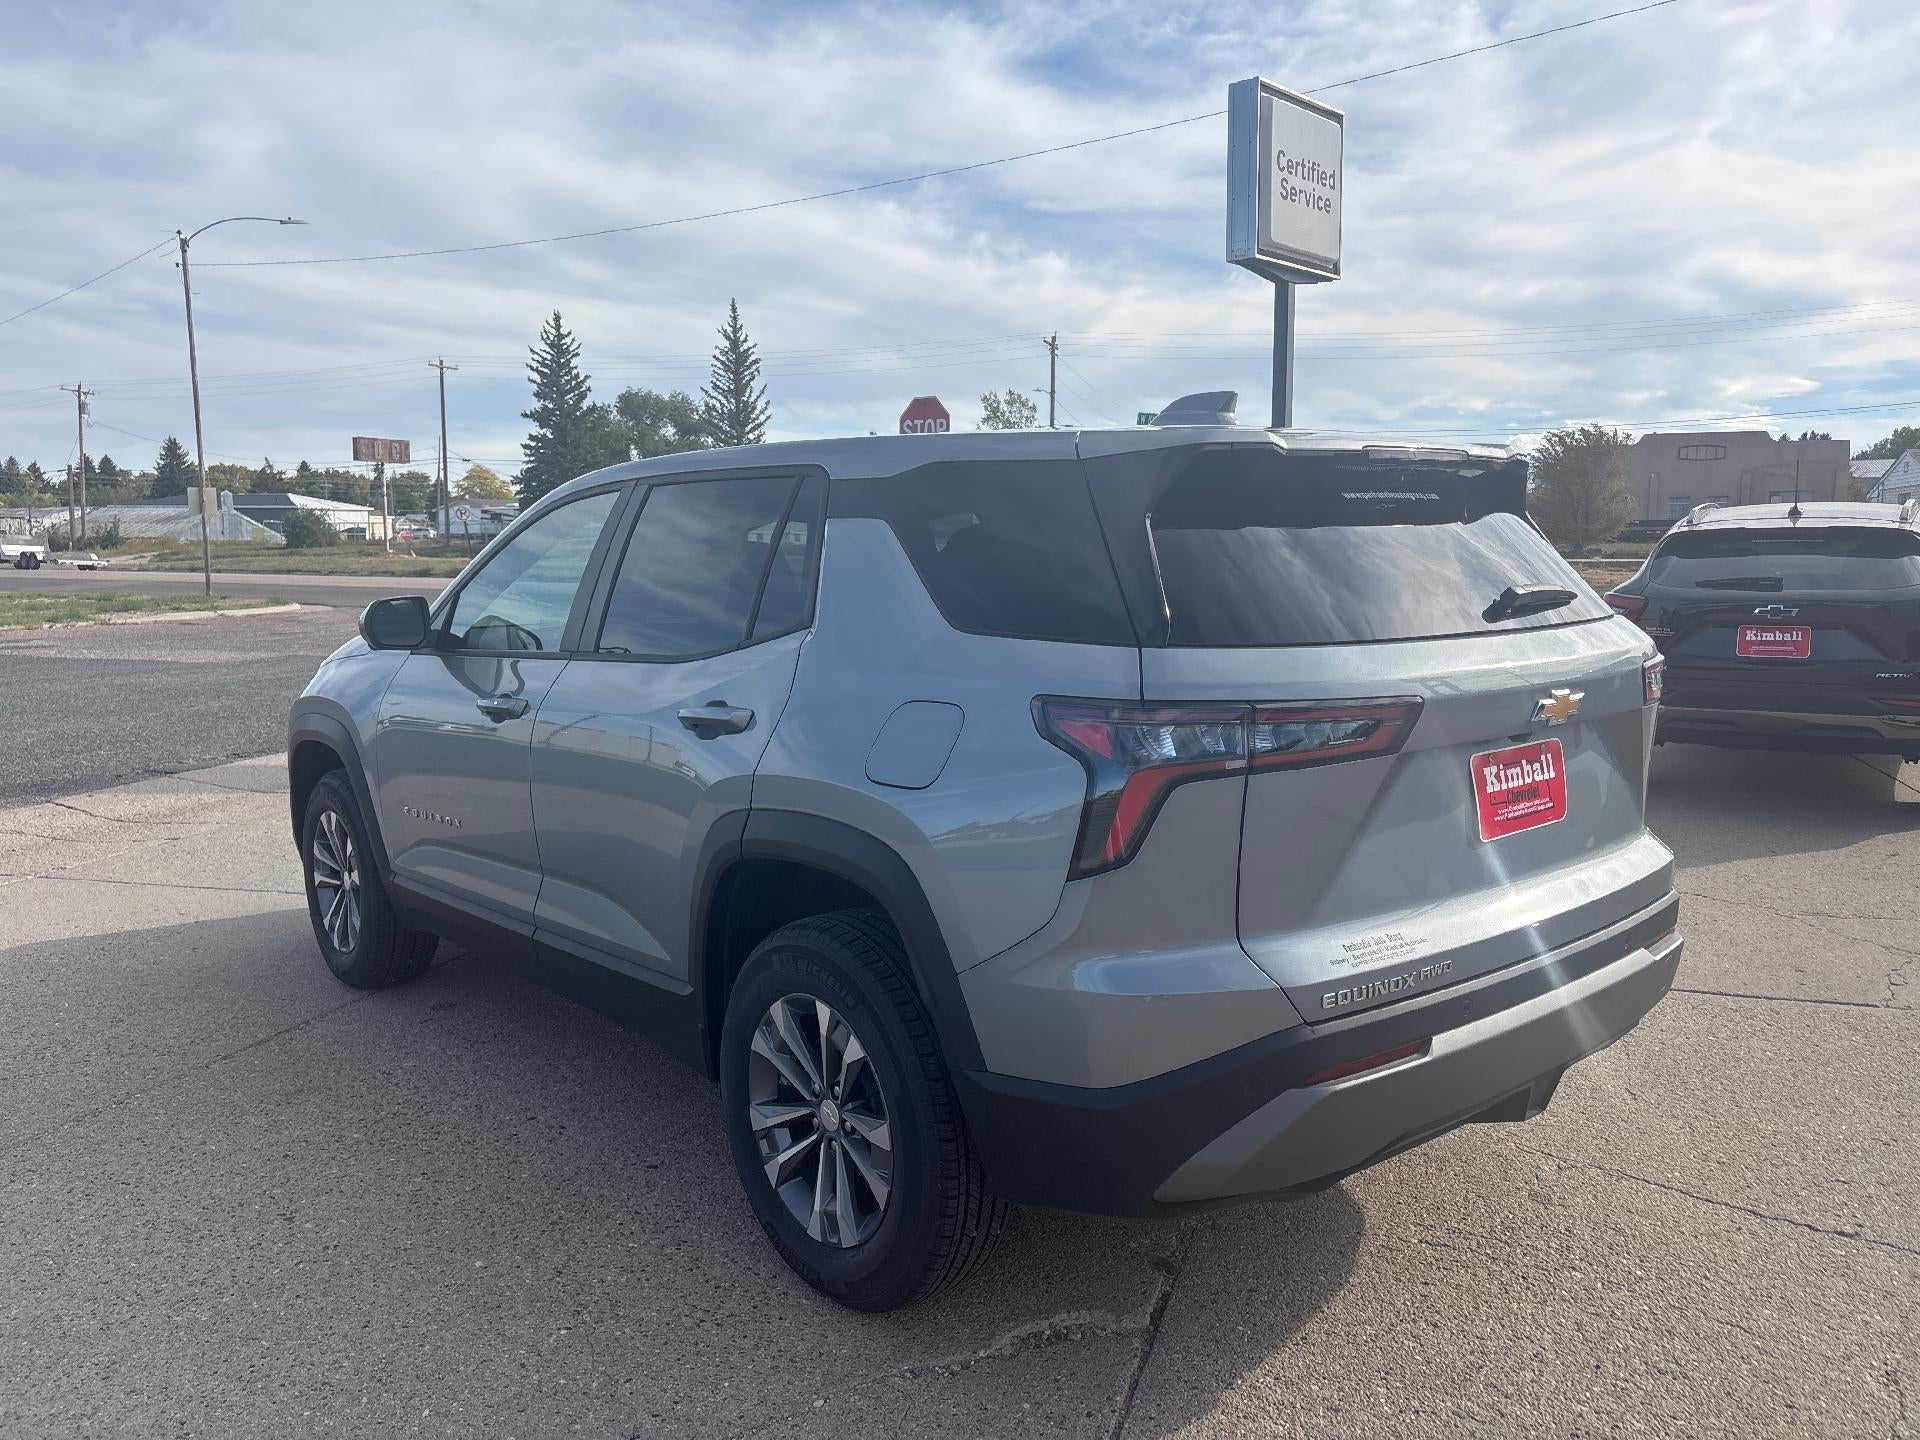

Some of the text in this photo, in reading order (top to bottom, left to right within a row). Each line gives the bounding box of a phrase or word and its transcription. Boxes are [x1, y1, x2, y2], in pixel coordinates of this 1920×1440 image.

[1277, 150, 1336, 190] Certified
[1280, 177, 1332, 214] Service
[903, 418, 947, 434] STOP
[1745, 630, 1802, 641] Kimball
[1483, 753, 1556, 794] Kimball
[404, 806, 462, 828] EQUINOX
[1321, 960, 1453, 1009] EQUINOX AWD
